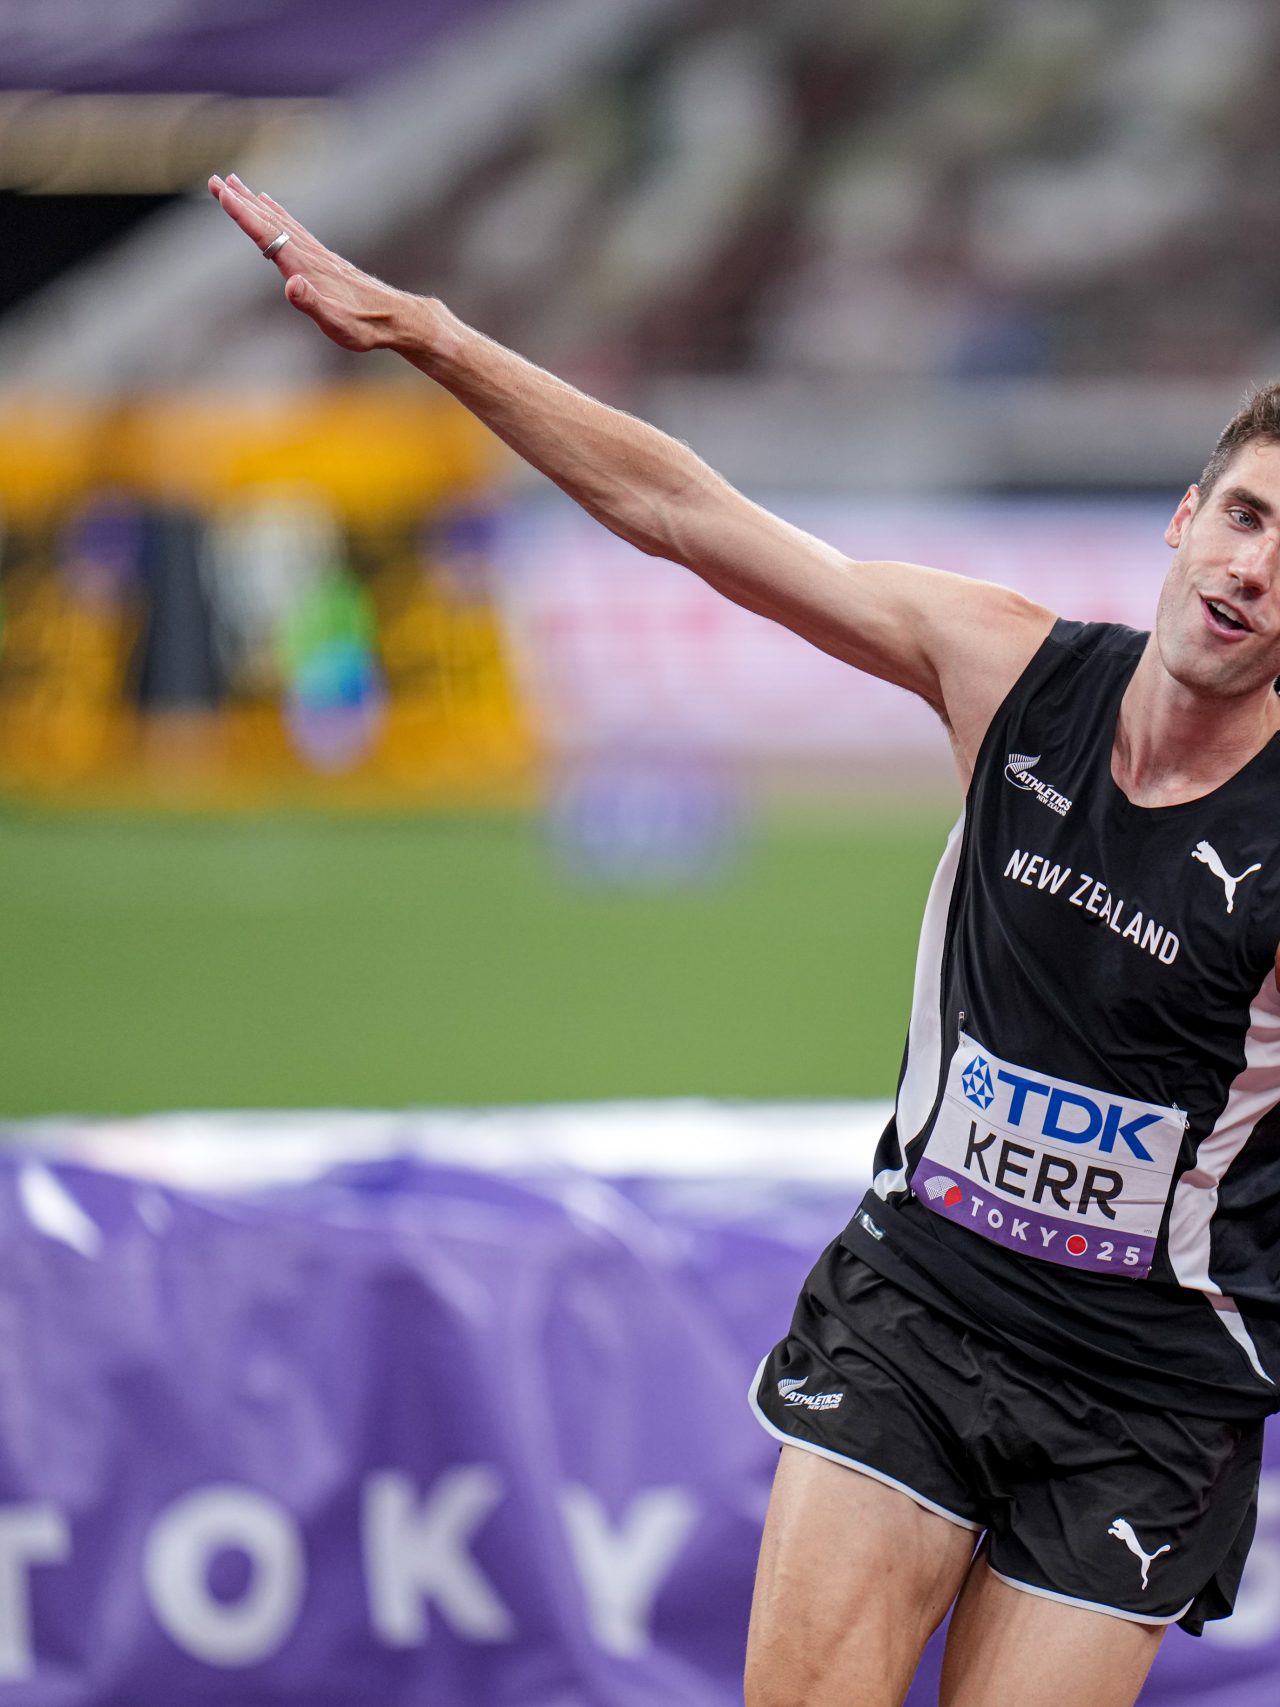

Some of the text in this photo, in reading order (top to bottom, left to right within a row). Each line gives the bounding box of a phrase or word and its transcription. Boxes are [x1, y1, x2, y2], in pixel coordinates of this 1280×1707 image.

[1015, 770, 1073, 811] ATHLETICS
[1035, 793, 1049, 805] NEW
[1003, 849, 1180, 965] NEW ZEALAND
[997, 1068, 1164, 1163] TDK
[963, 1120, 1124, 1220] KERR
[784, 1391, 844, 1405] ATHLETICS
